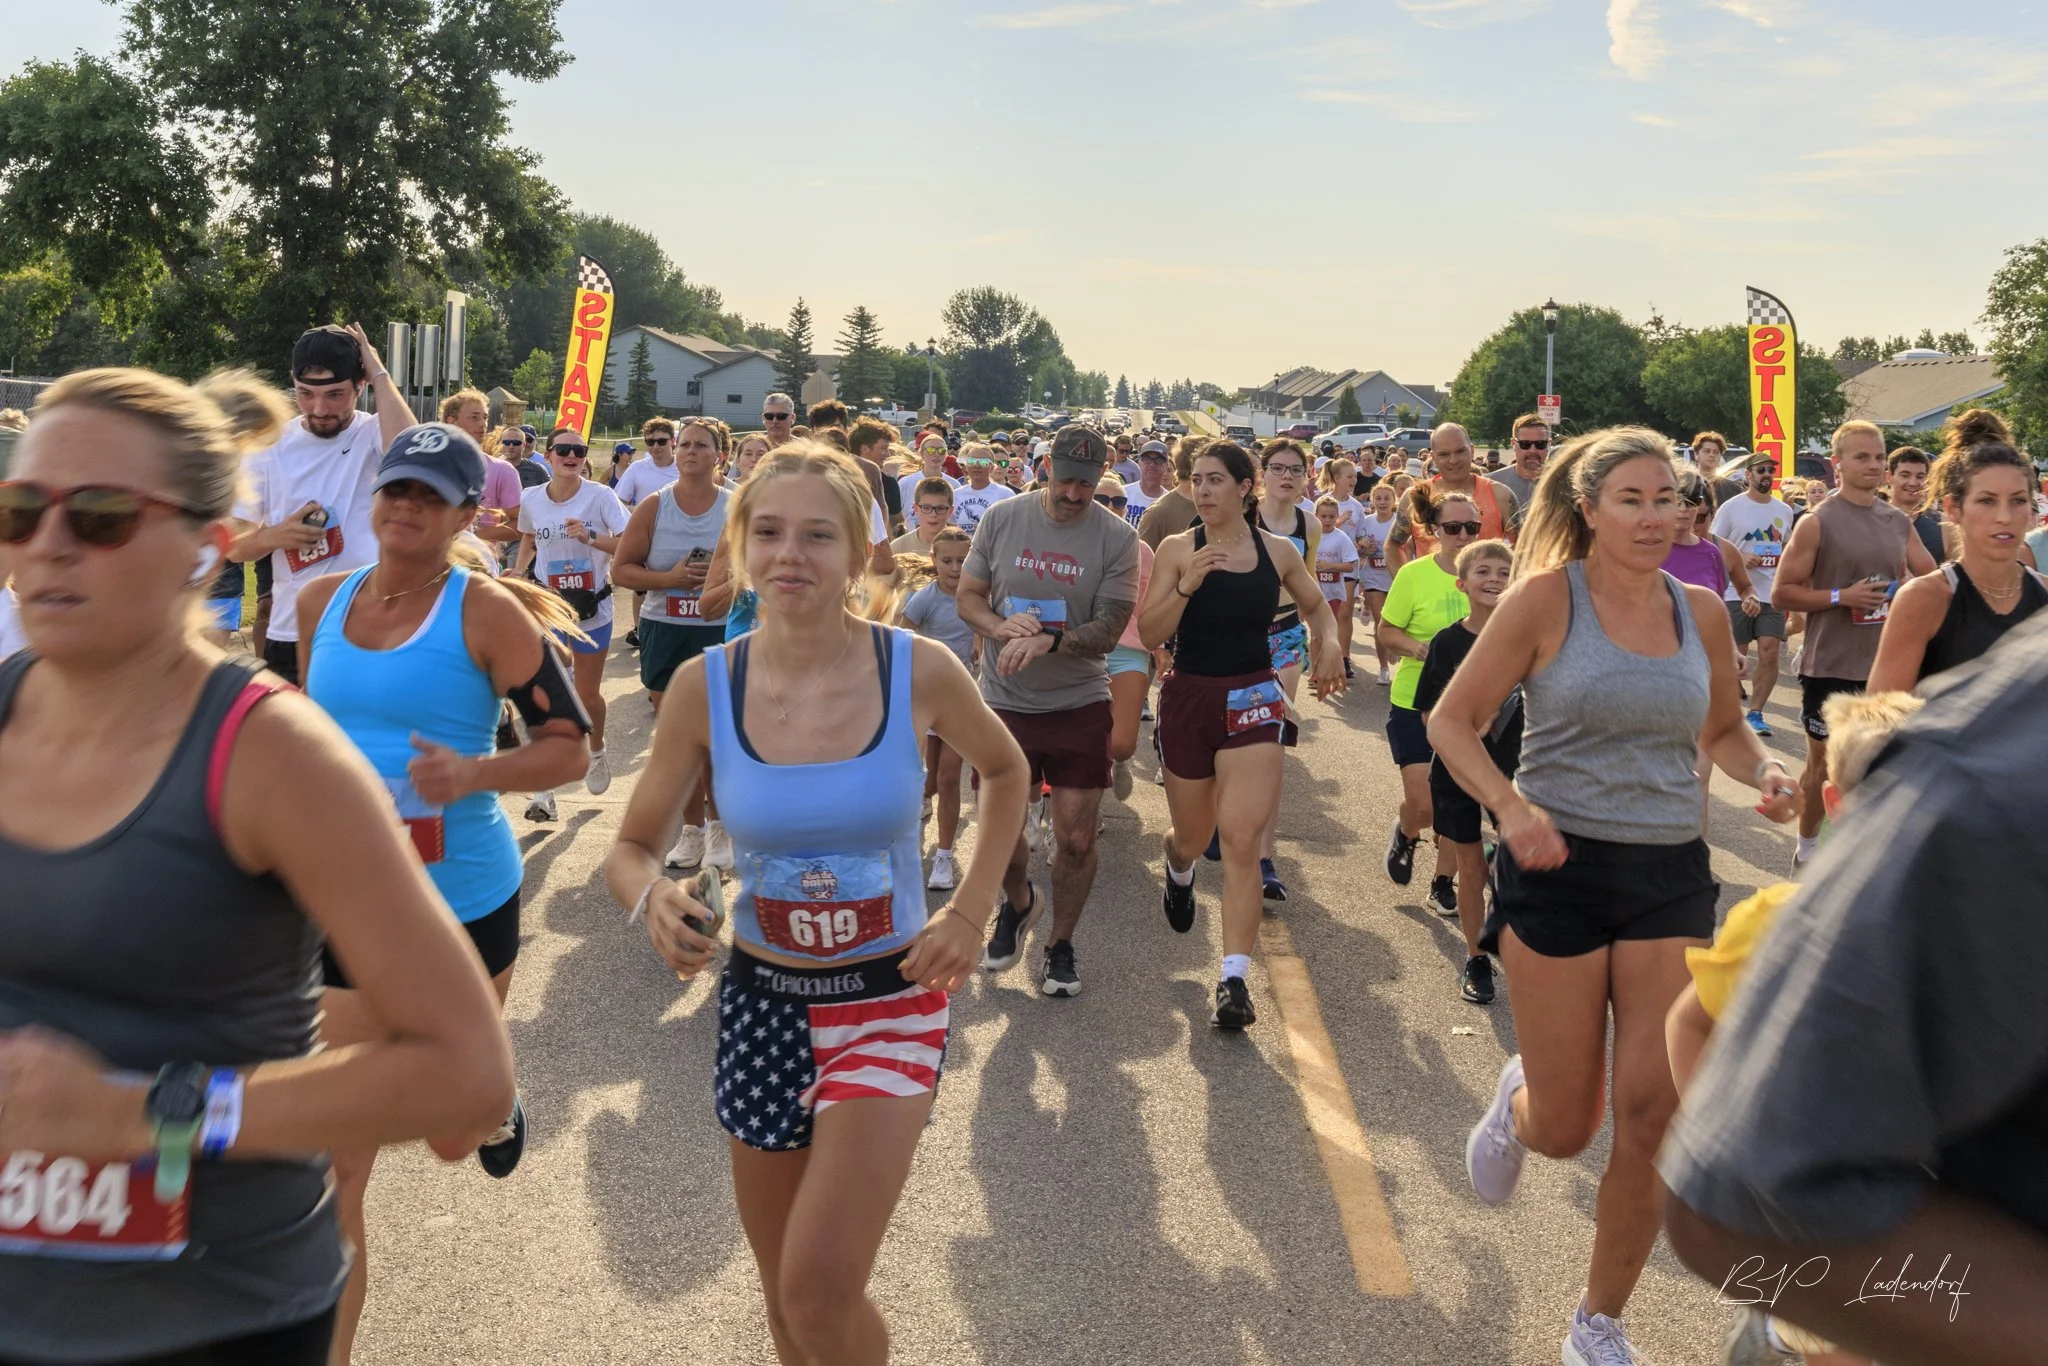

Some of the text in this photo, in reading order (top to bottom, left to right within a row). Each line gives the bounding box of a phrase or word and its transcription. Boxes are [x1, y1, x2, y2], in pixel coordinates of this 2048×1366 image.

[558, 574, 584, 590] 540
[1015, 556, 1085, 577] BEGIN TODAY
[788, 908, 858, 949] 619
[0, 1149, 132, 1238] 564
